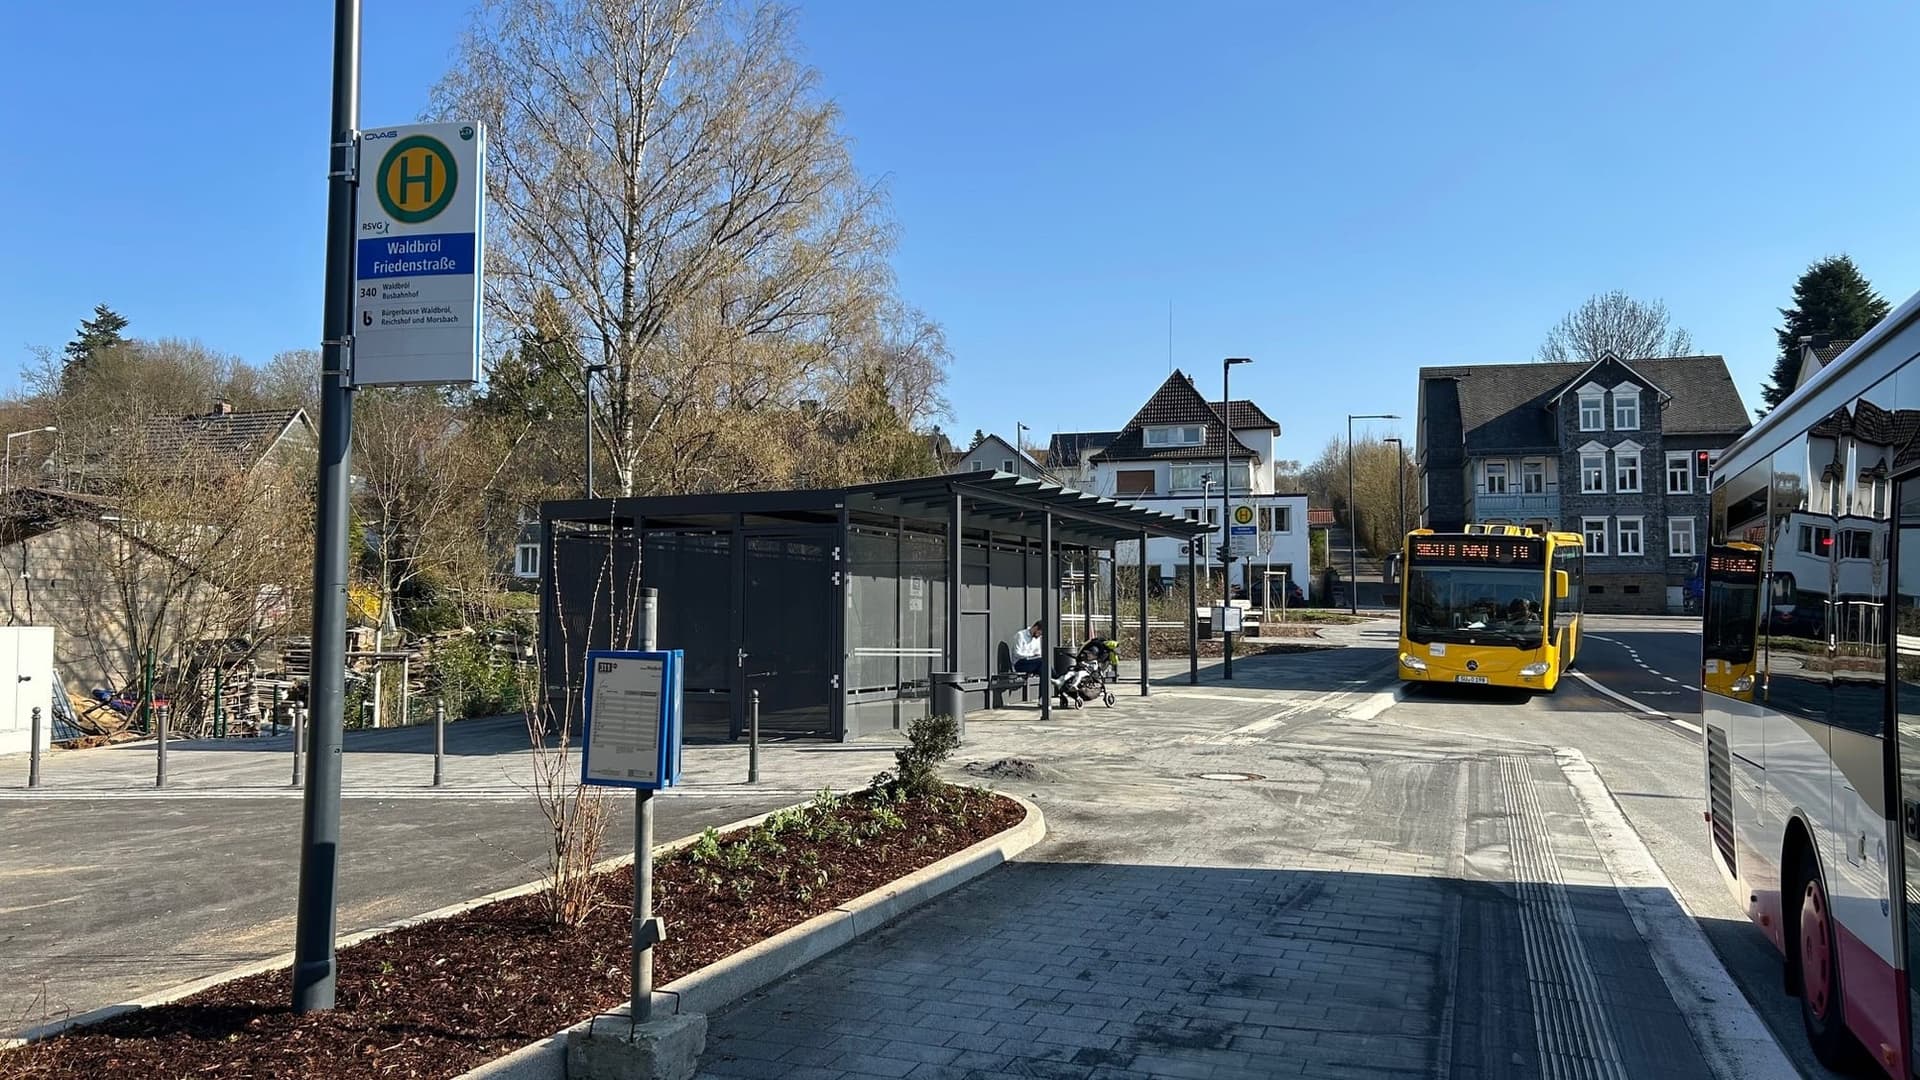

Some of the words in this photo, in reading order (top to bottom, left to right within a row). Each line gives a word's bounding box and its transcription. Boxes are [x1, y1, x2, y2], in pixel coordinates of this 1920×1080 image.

[400, 155, 432, 204] H
[362, 222, 382, 231] RSVG
[387, 239, 441, 254] Waldbröl
[374, 257, 456, 273] Friedenstraße
[383, 282, 410, 290] Waldbröl
[360, 287, 377, 297] 340
[382, 290, 419, 299] Busbahnhof
[382, 308, 419, 317] Bürgerbusse
[381, 317, 411, 325] Reichshof
[412, 316, 425, 324] und
[426, 315, 459, 323] Morsbach
